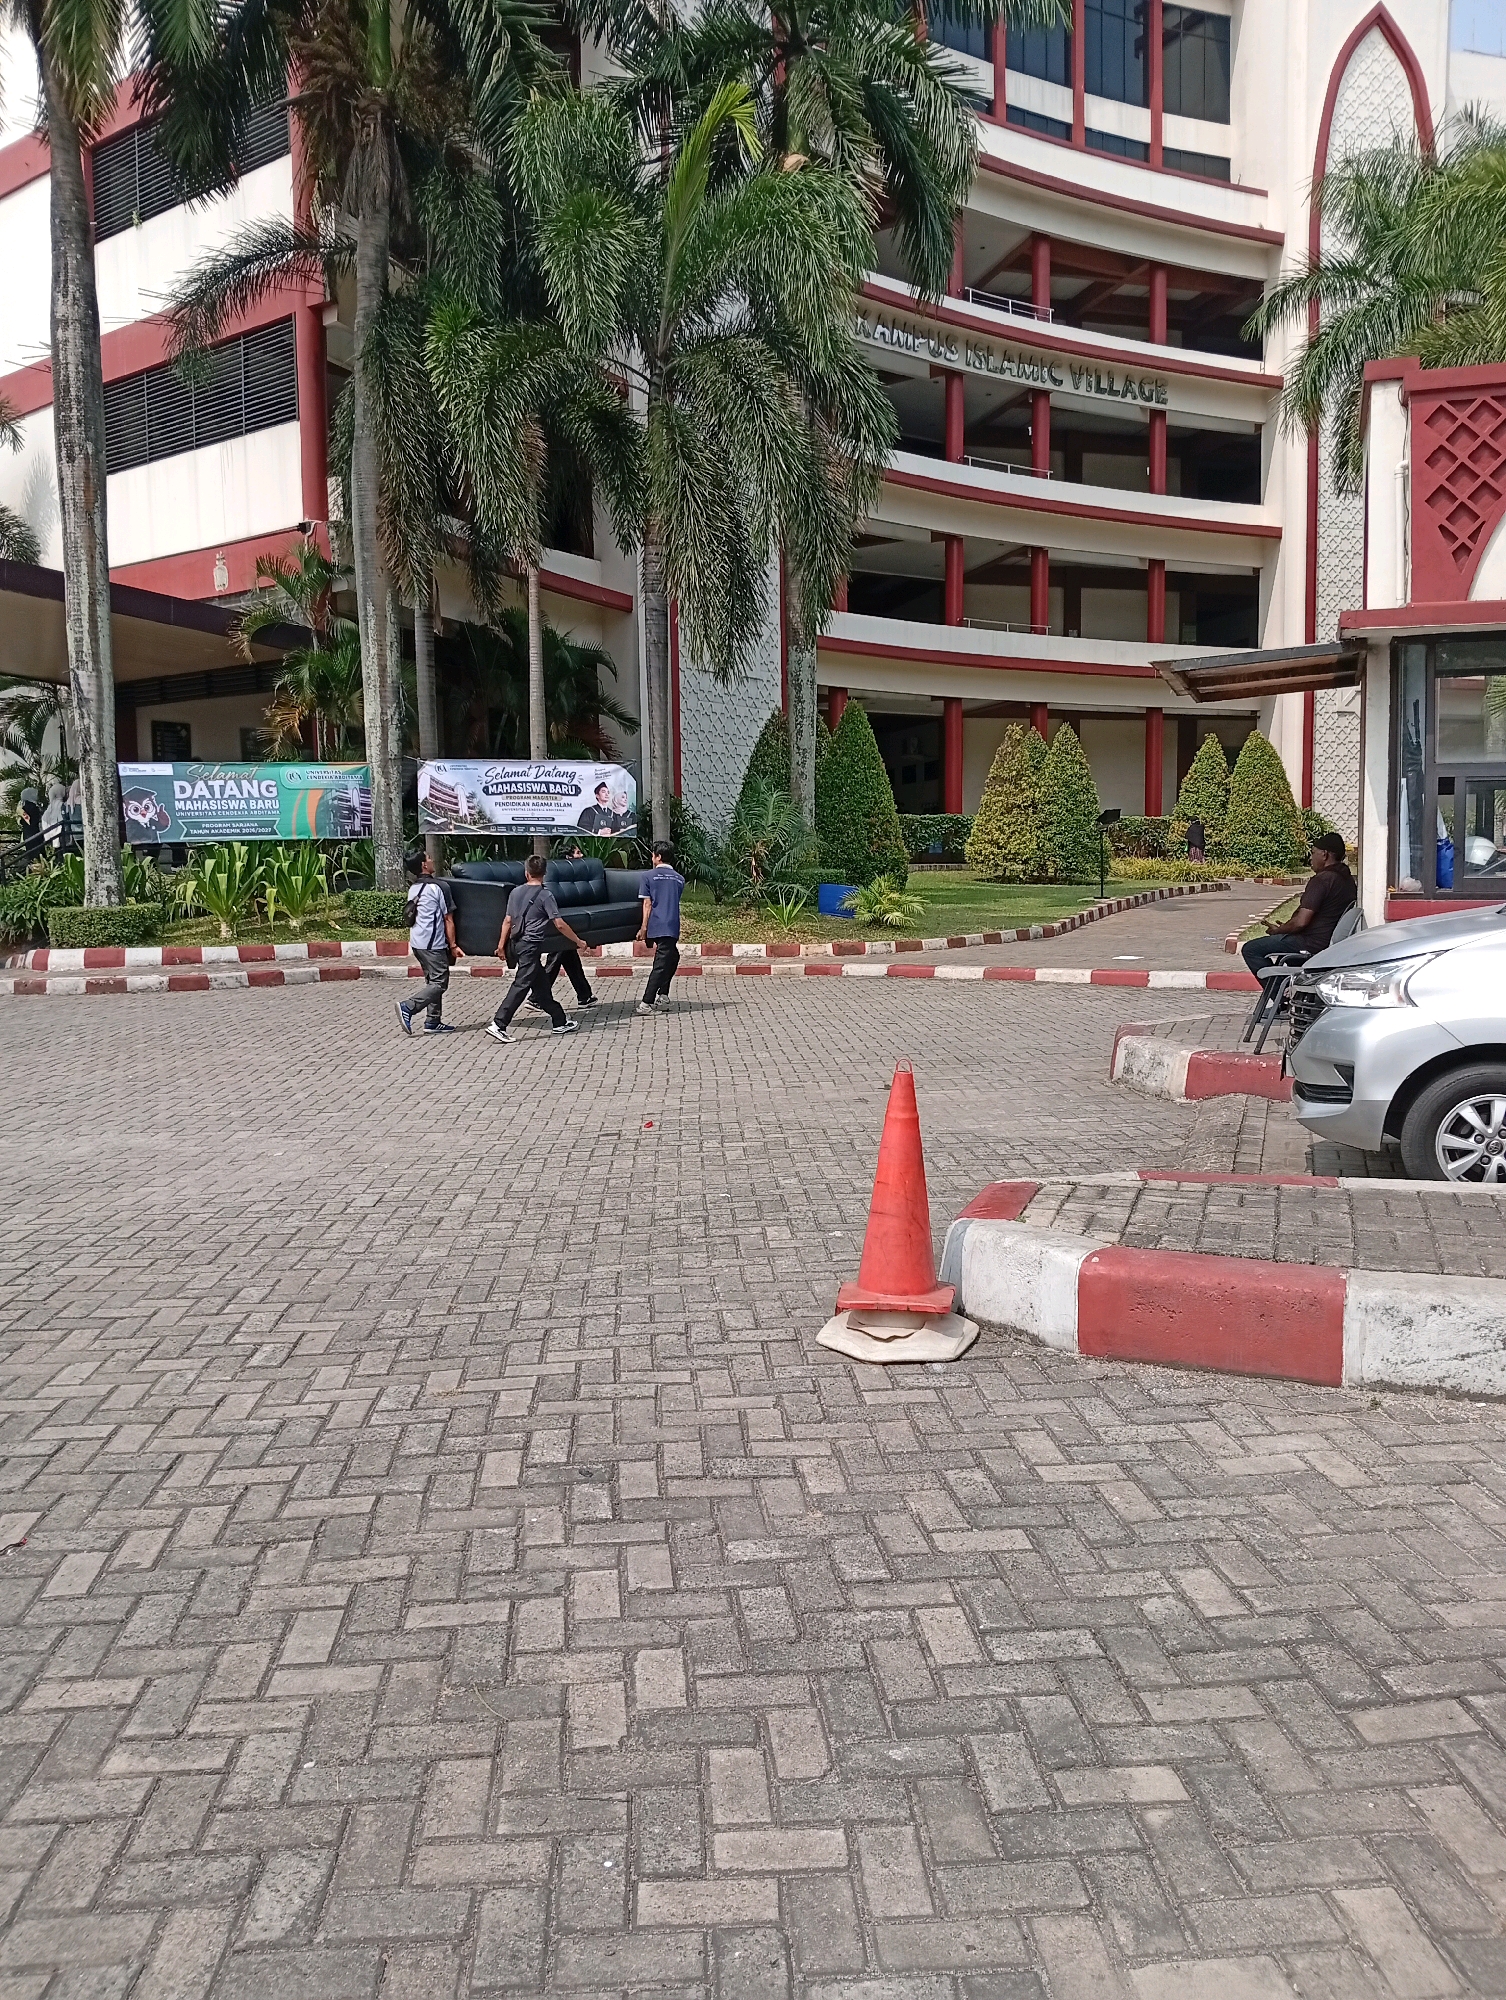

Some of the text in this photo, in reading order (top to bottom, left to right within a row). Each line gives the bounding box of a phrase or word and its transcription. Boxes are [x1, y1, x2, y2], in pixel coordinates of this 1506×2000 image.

[855, 307, 1169, 405] KAMPUS ISLAMIC VILLAGE
[186, 764, 266, 785] Selamat
[485, 764, 533, 784] Selamat
[533, 765, 577, 784] Datang
[173, 779, 278, 799] DATANG
[488, 782, 576, 795] MAHASISWA BARU
[174, 799, 280, 811] MAHASISWA BARU
